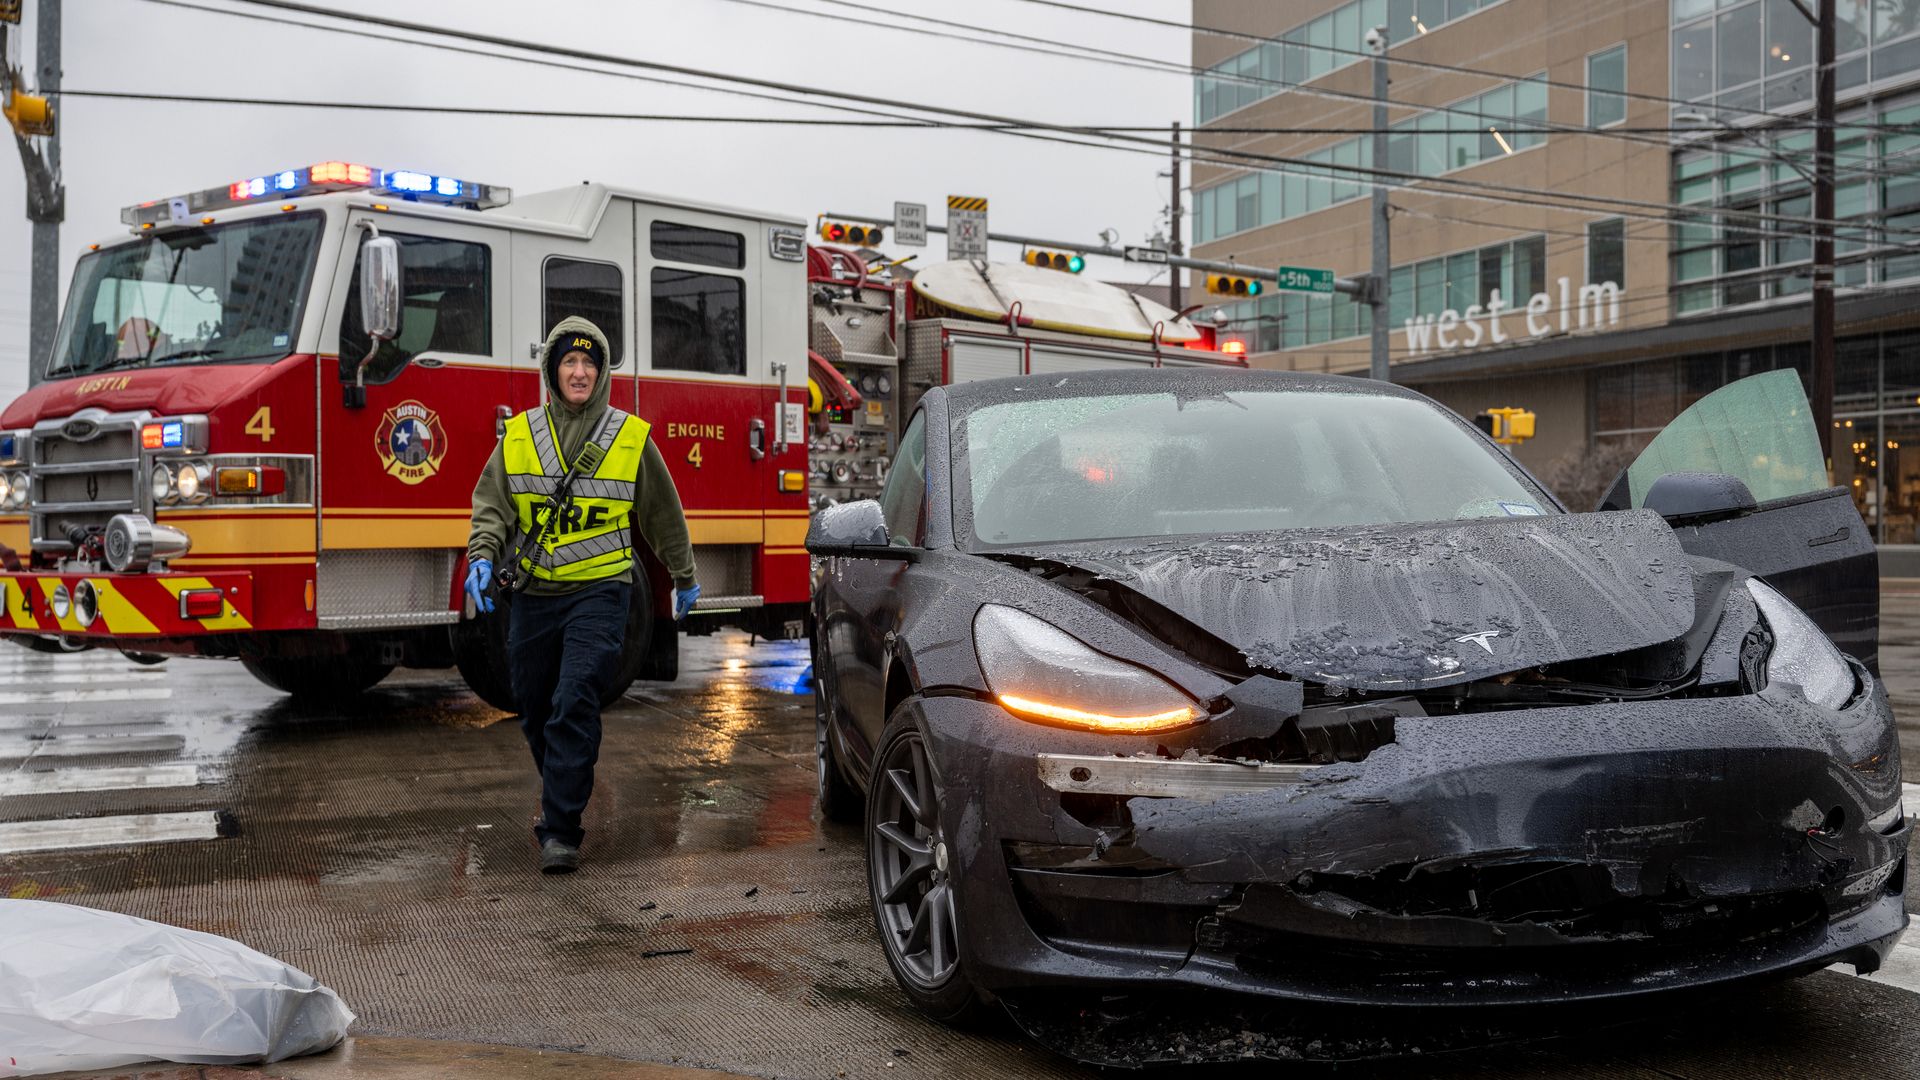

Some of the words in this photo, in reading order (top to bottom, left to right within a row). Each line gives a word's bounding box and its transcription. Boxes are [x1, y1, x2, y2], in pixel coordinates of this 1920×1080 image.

[901, 207, 920, 216] LEFT
[900, 219, 920, 229] TURN
[897, 232, 924, 242] SIGNAL
[1287, 271, 1311, 288] 5th
[1405, 288, 1508, 356] west
[1526, 277, 1619, 337] elm
[573, 337, 592, 350] AFD
[75, 376, 132, 395] AUSTIN
[397, 404, 426, 419] AUSTIN
[245, 406, 275, 442] 4
[667, 423, 725, 440] ENGINE
[688, 442, 702, 468] 4
[399, 467, 425, 477] FIRE
[22, 587, 34, 618] 4
